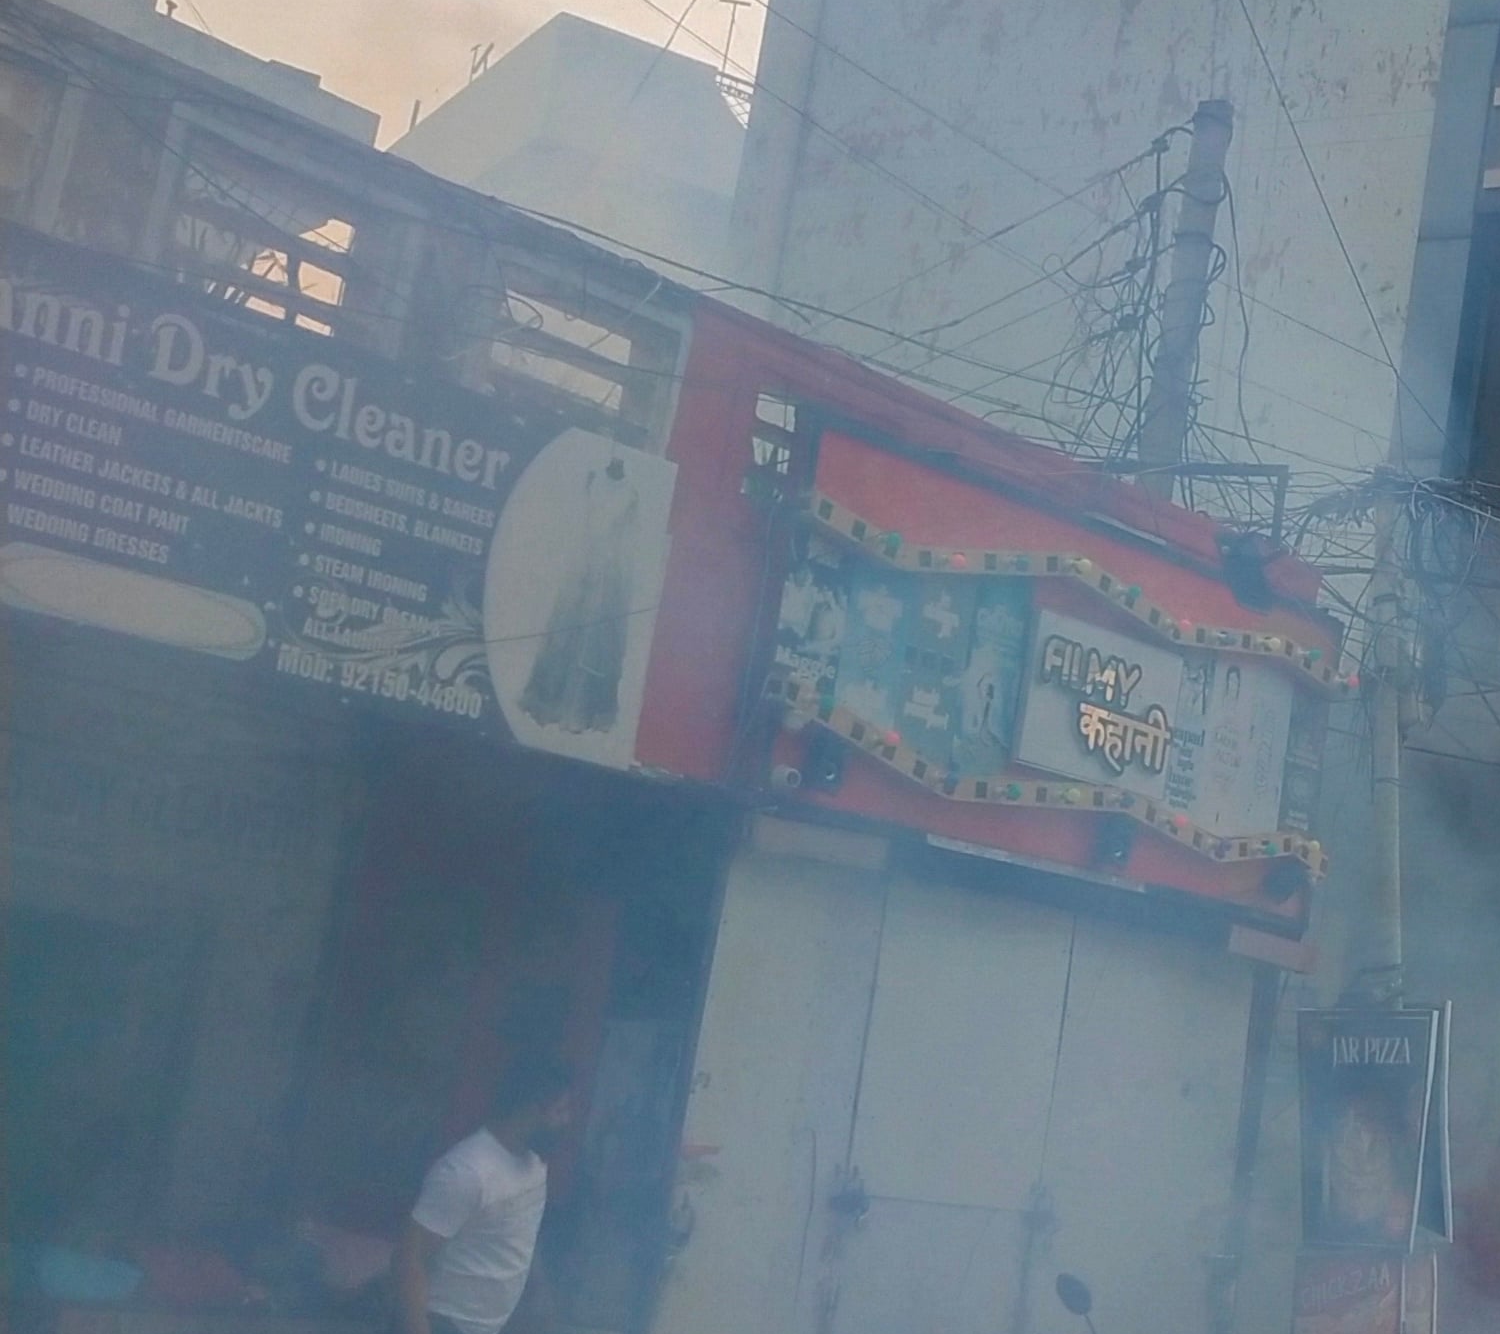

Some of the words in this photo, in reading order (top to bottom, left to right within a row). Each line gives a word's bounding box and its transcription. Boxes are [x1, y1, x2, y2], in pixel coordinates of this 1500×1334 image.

[26, 399, 63, 428] DRY
[65, 412, 124, 447] CLEAN
[32, 366, 160, 423] PROFESSIONAL
[147, 312, 275, 420] Dry
[293, 364, 511, 491] Cleaner
[13, 467, 96, 510] WEDDING
[99, 494, 144, 524] COAT
[146, 508, 192, 536] PANT
[19, 433, 95, 474] LEATHER
[98, 458, 172, 497] JACKETS
[175, 480, 189, 500] &
[191, 486, 219, 511] ALL
[223, 495, 285, 529] JACKTS
[330, 460, 384, 494] LADIES
[385, 477, 427, 507] SUITS
[428, 492, 440, 511] &
[442, 497, 496, 529] SAREES
[7, 503, 90, 544] WEDDING
[92, 527, 170, 565] DRESSES
[320, 522, 383, 557] IRONING
[414, 519, 485, 556] BLANKETS
[315, 554, 363, 585] STEAM
[366, 566, 428, 603] IRONING
[350, 597, 381, 621] DRY
[1041, 633, 1144, 707] FILMY
[1076, 699, 1172, 776] कहानी
[1364, 1036, 1412, 1067] PIZZA
